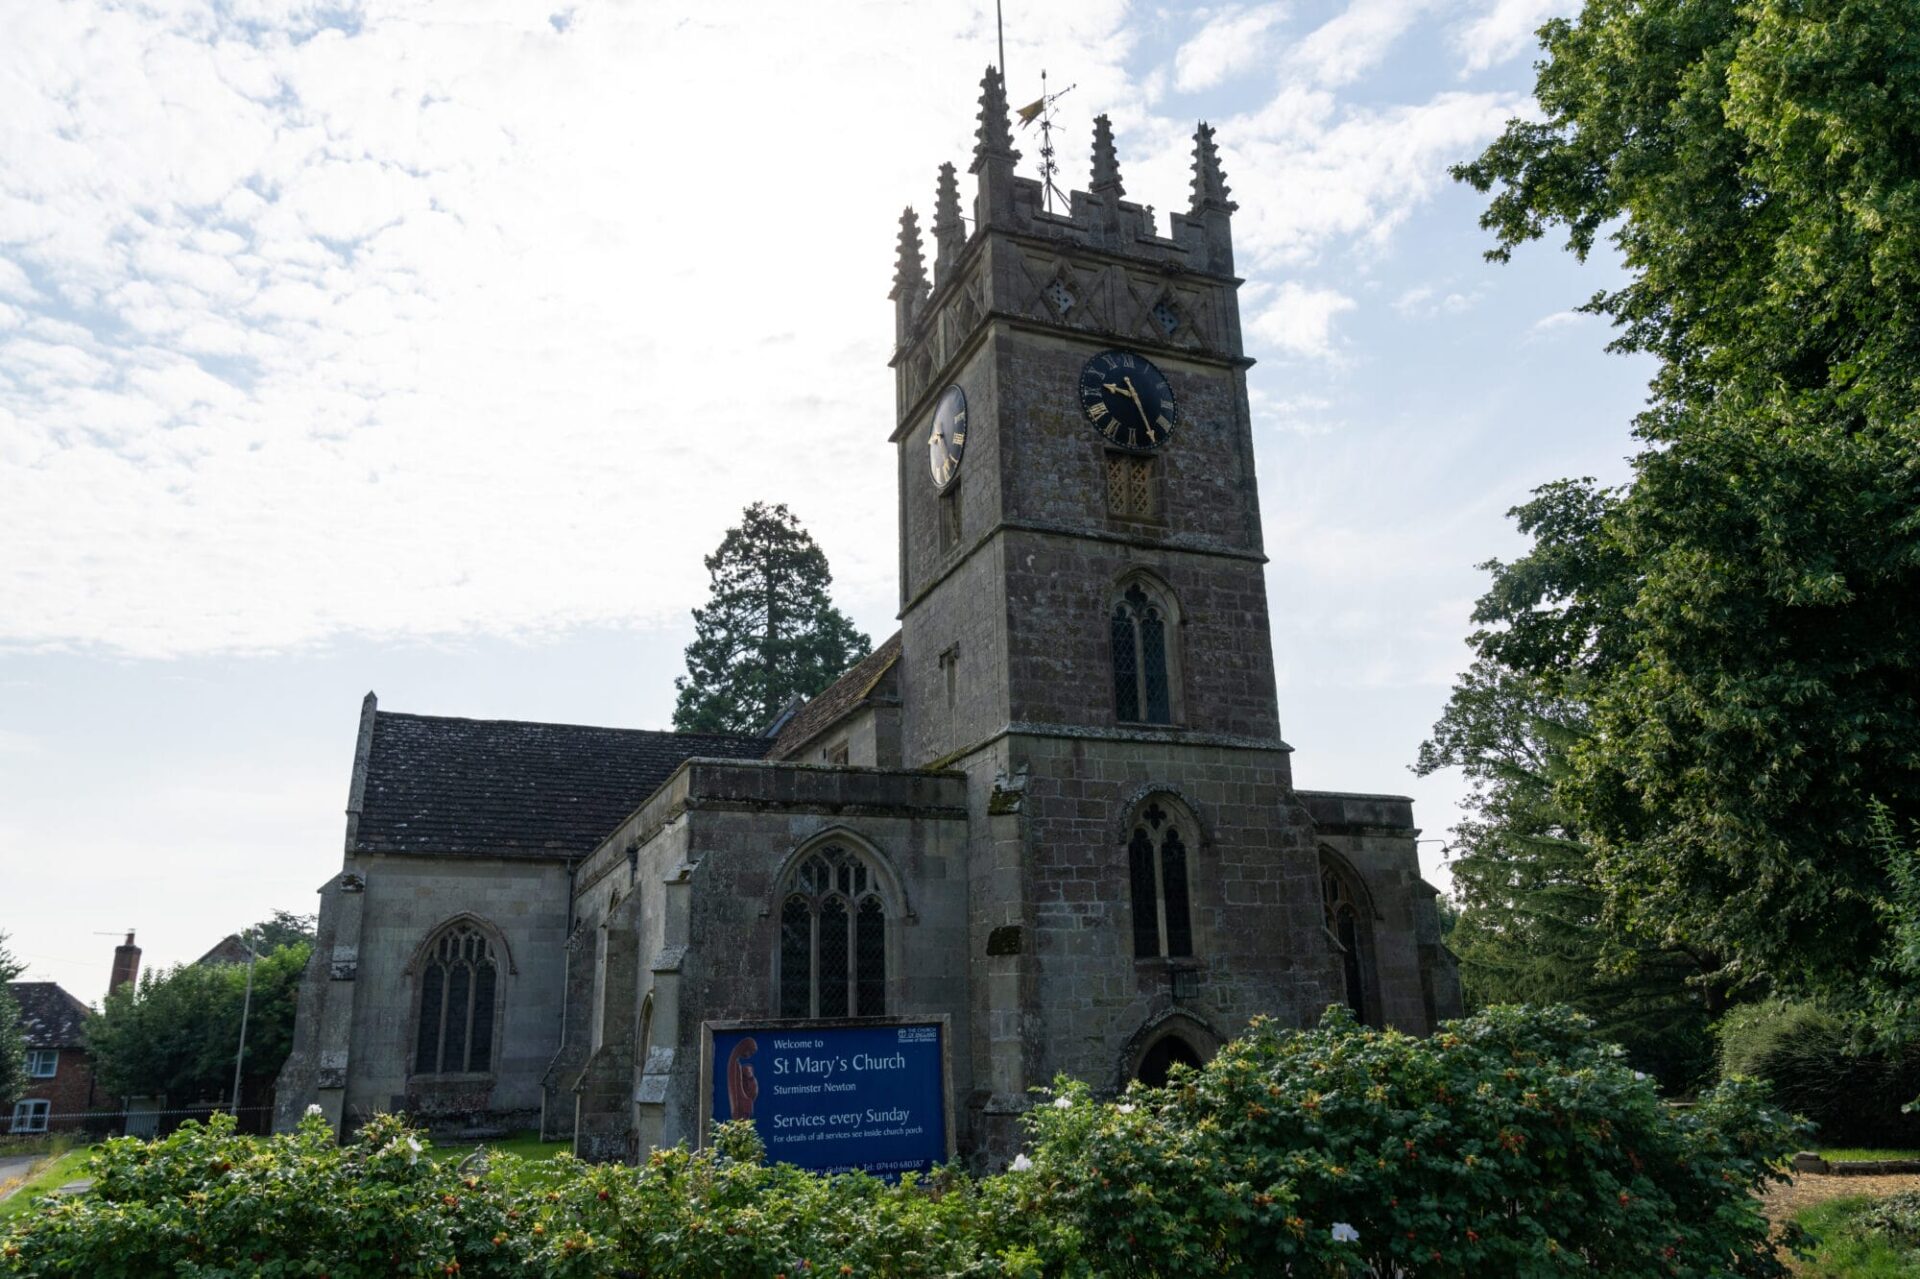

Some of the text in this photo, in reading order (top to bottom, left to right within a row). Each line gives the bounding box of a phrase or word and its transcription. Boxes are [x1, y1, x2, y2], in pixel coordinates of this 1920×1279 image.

[774, 1039, 824, 1049] Welcome to
[773, 1051, 906, 1079] St Mary's Church
[773, 1082, 857, 1095] Sturminster Newton
[773, 1106, 910, 1128] Services every Sunday
[773, 1135, 784, 1143] For
[785, 1133, 807, 1142] details
[807, 1132, 815, 1141] of
[816, 1132, 824, 1140] all
[825, 1131, 851, 1139] services
[863, 1129, 882, 1137] inside
[883, 1127, 903, 1136] church
[905, 1125, 924, 1136] porch
[876, 1161, 899, 1170] 07440
[899, 1159, 925, 1168] 680387
